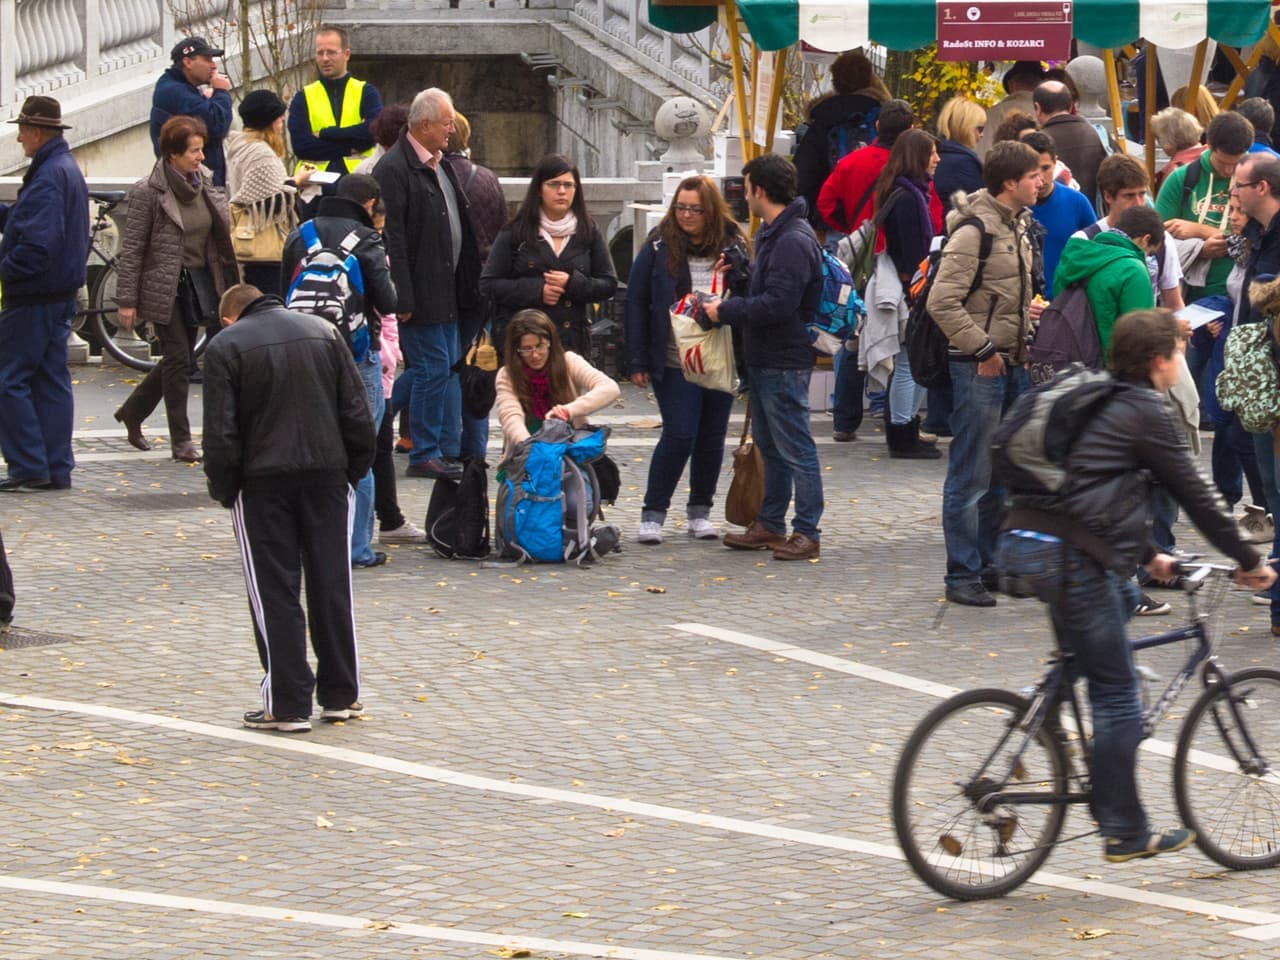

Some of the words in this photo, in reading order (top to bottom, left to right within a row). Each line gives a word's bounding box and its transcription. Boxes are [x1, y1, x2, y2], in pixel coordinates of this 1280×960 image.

[943, 8, 957, 20] 1.
[974, 40, 996, 48] INFO
[997, 40, 1005, 48] &
[1006, 40, 1045, 48] KOZARCI
